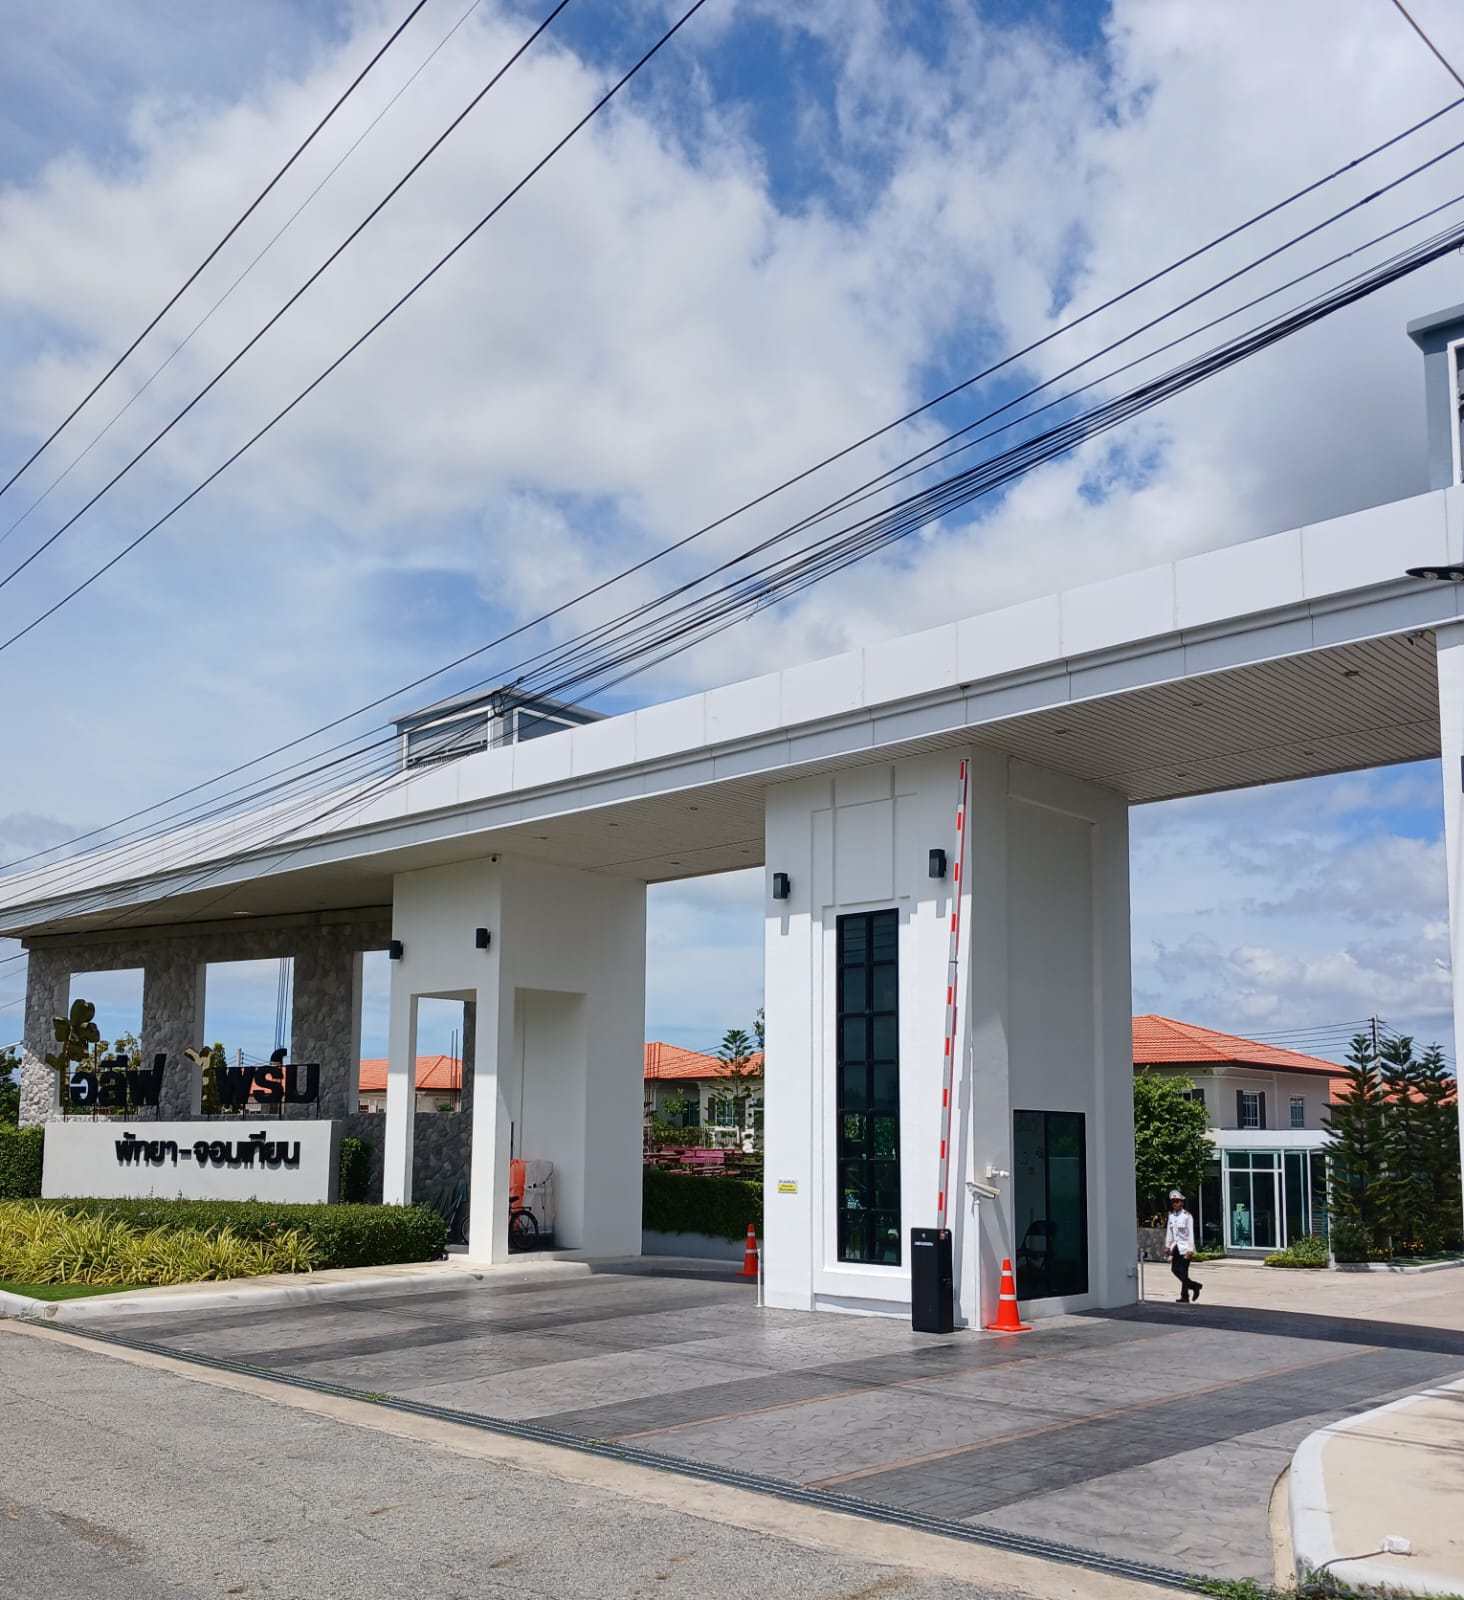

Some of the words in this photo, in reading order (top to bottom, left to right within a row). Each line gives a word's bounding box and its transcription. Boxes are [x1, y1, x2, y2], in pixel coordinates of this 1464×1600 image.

[114, 1131, 301, 1165] พัทยา-จอมเทียน
